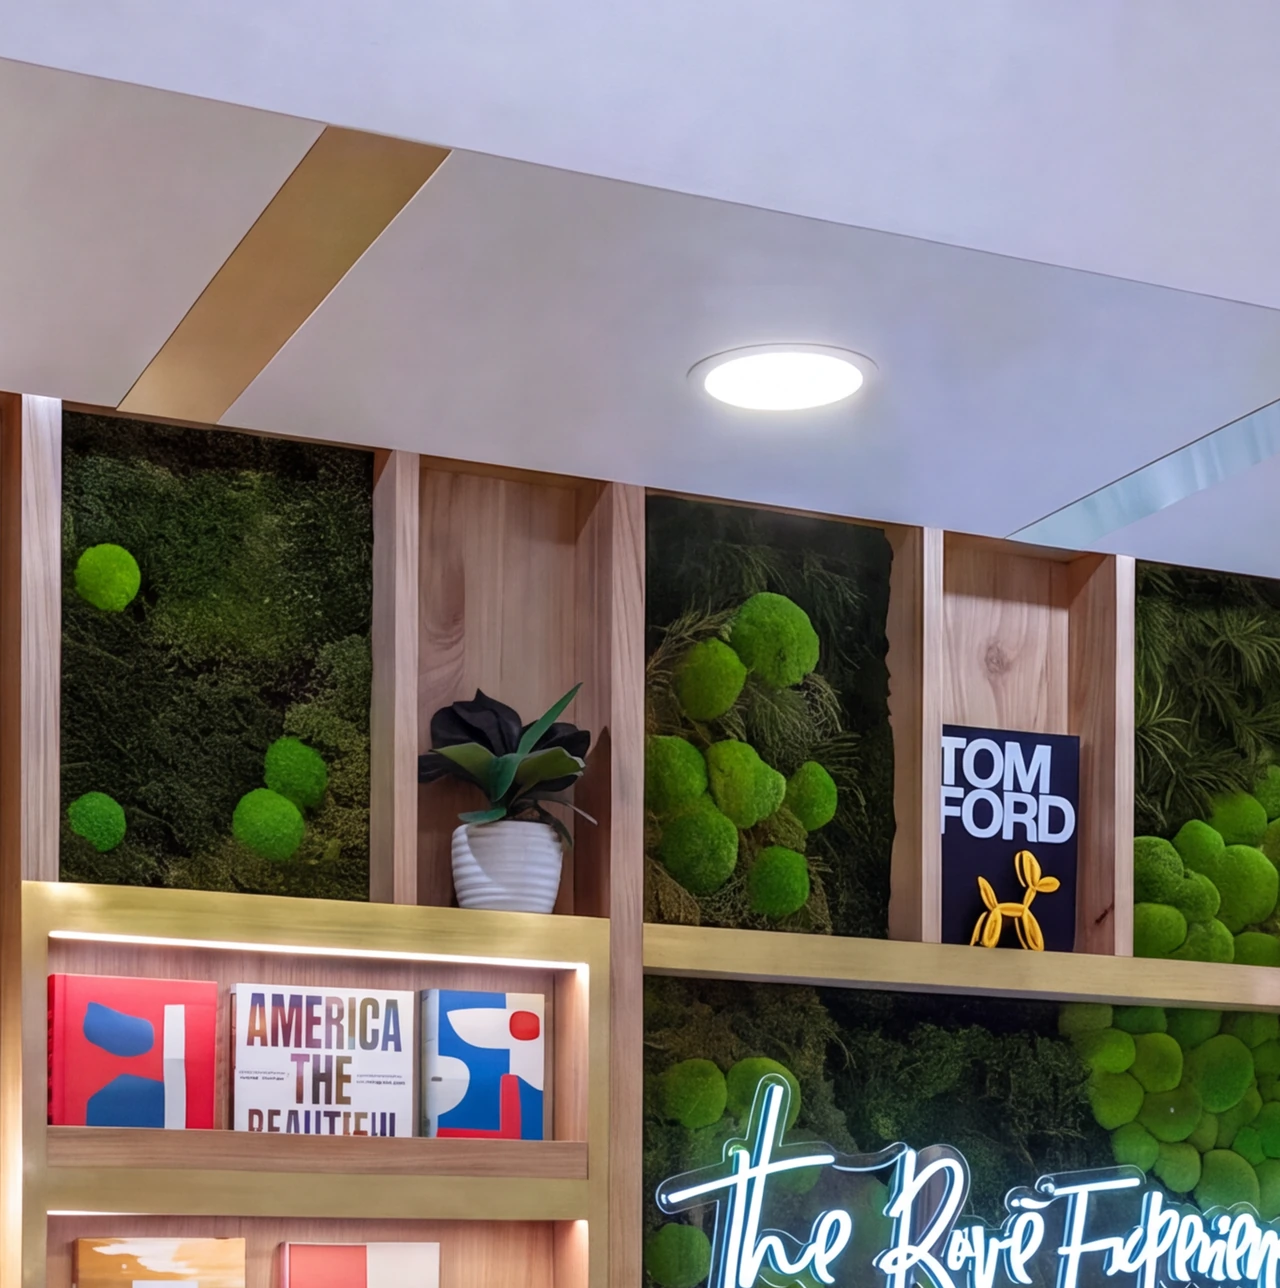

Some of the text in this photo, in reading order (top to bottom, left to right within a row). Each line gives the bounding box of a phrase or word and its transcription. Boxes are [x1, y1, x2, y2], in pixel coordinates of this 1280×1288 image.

[941, 735, 1052, 794] TOM
[940, 785, 1076, 844] FORD
[246, 993, 402, 1052] AMERICA
[290, 1053, 353, 1105] THE
